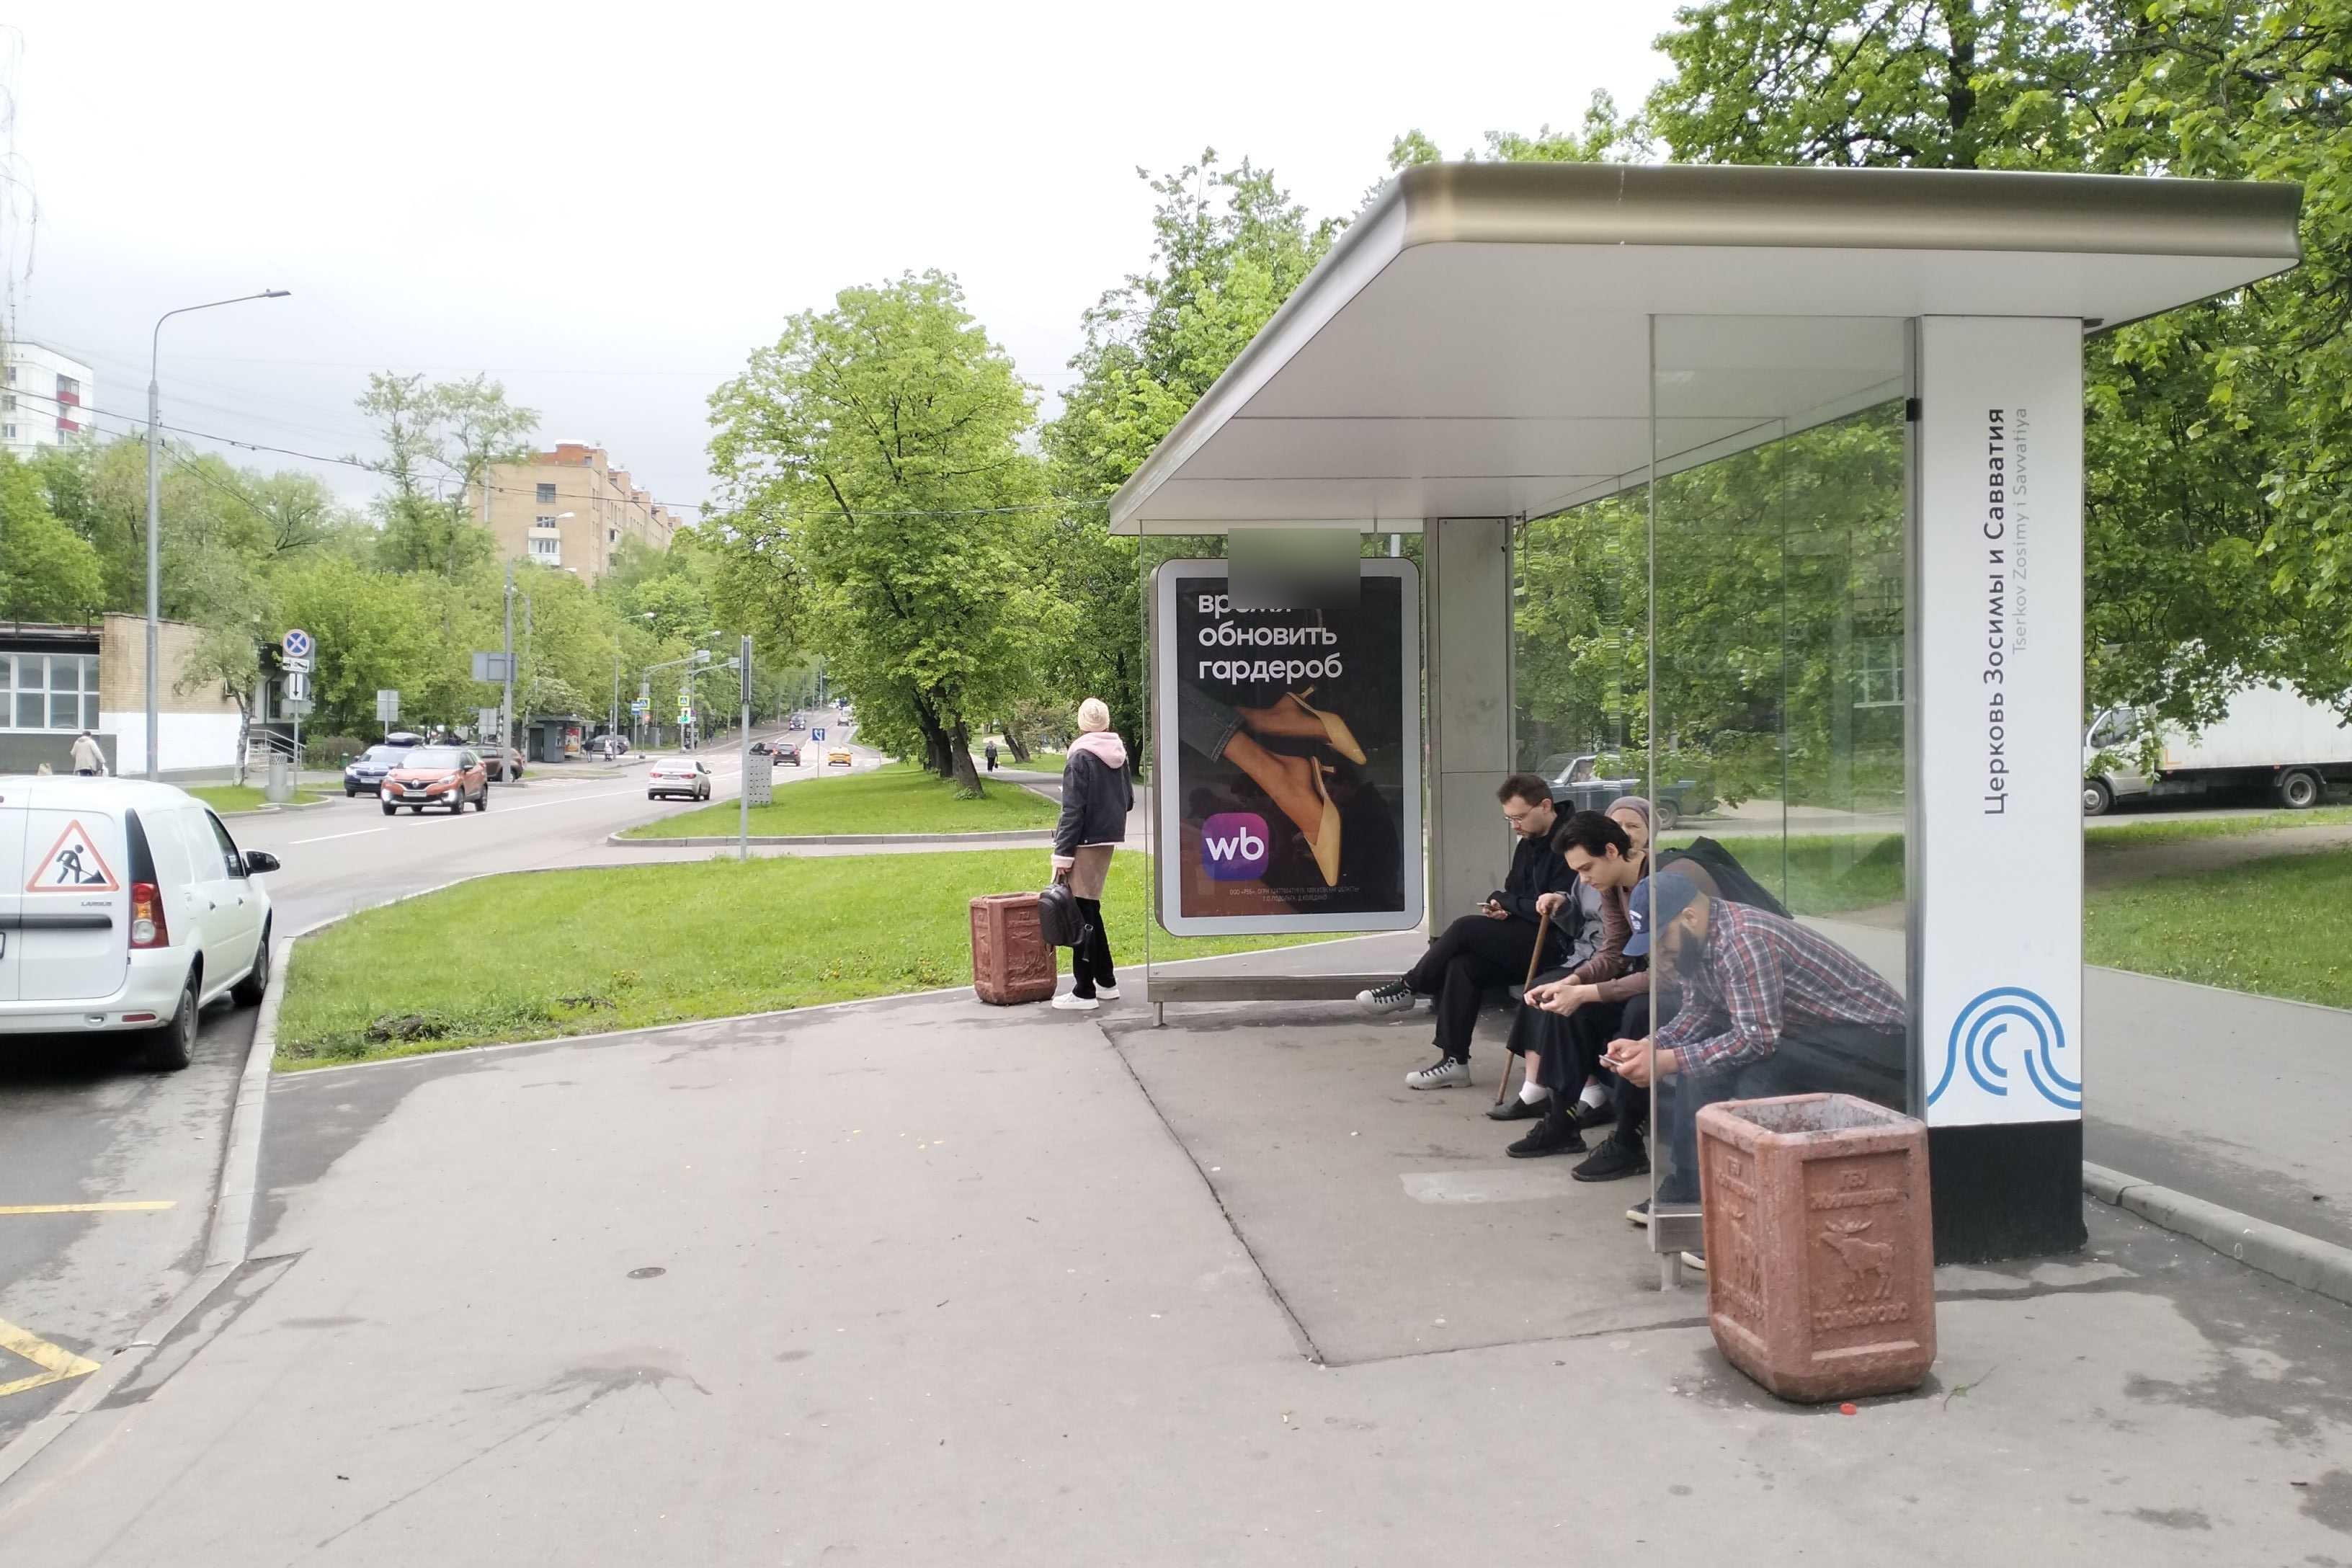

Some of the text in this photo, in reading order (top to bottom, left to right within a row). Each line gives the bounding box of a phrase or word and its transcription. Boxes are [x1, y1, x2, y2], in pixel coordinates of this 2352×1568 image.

[2013, 409, 2029, 496] Savvatiya
[2013, 512, 2029, 580] Zosimy
[1198, 620, 1337, 646] обновить
[1983, 409, 2009, 814] Церковь Зосимы и Савватия
[2012, 586, 2027, 655] Tserkov
[1199, 652, 1343, 685] гардероб
[1205, 827, 1265, 861] wb
